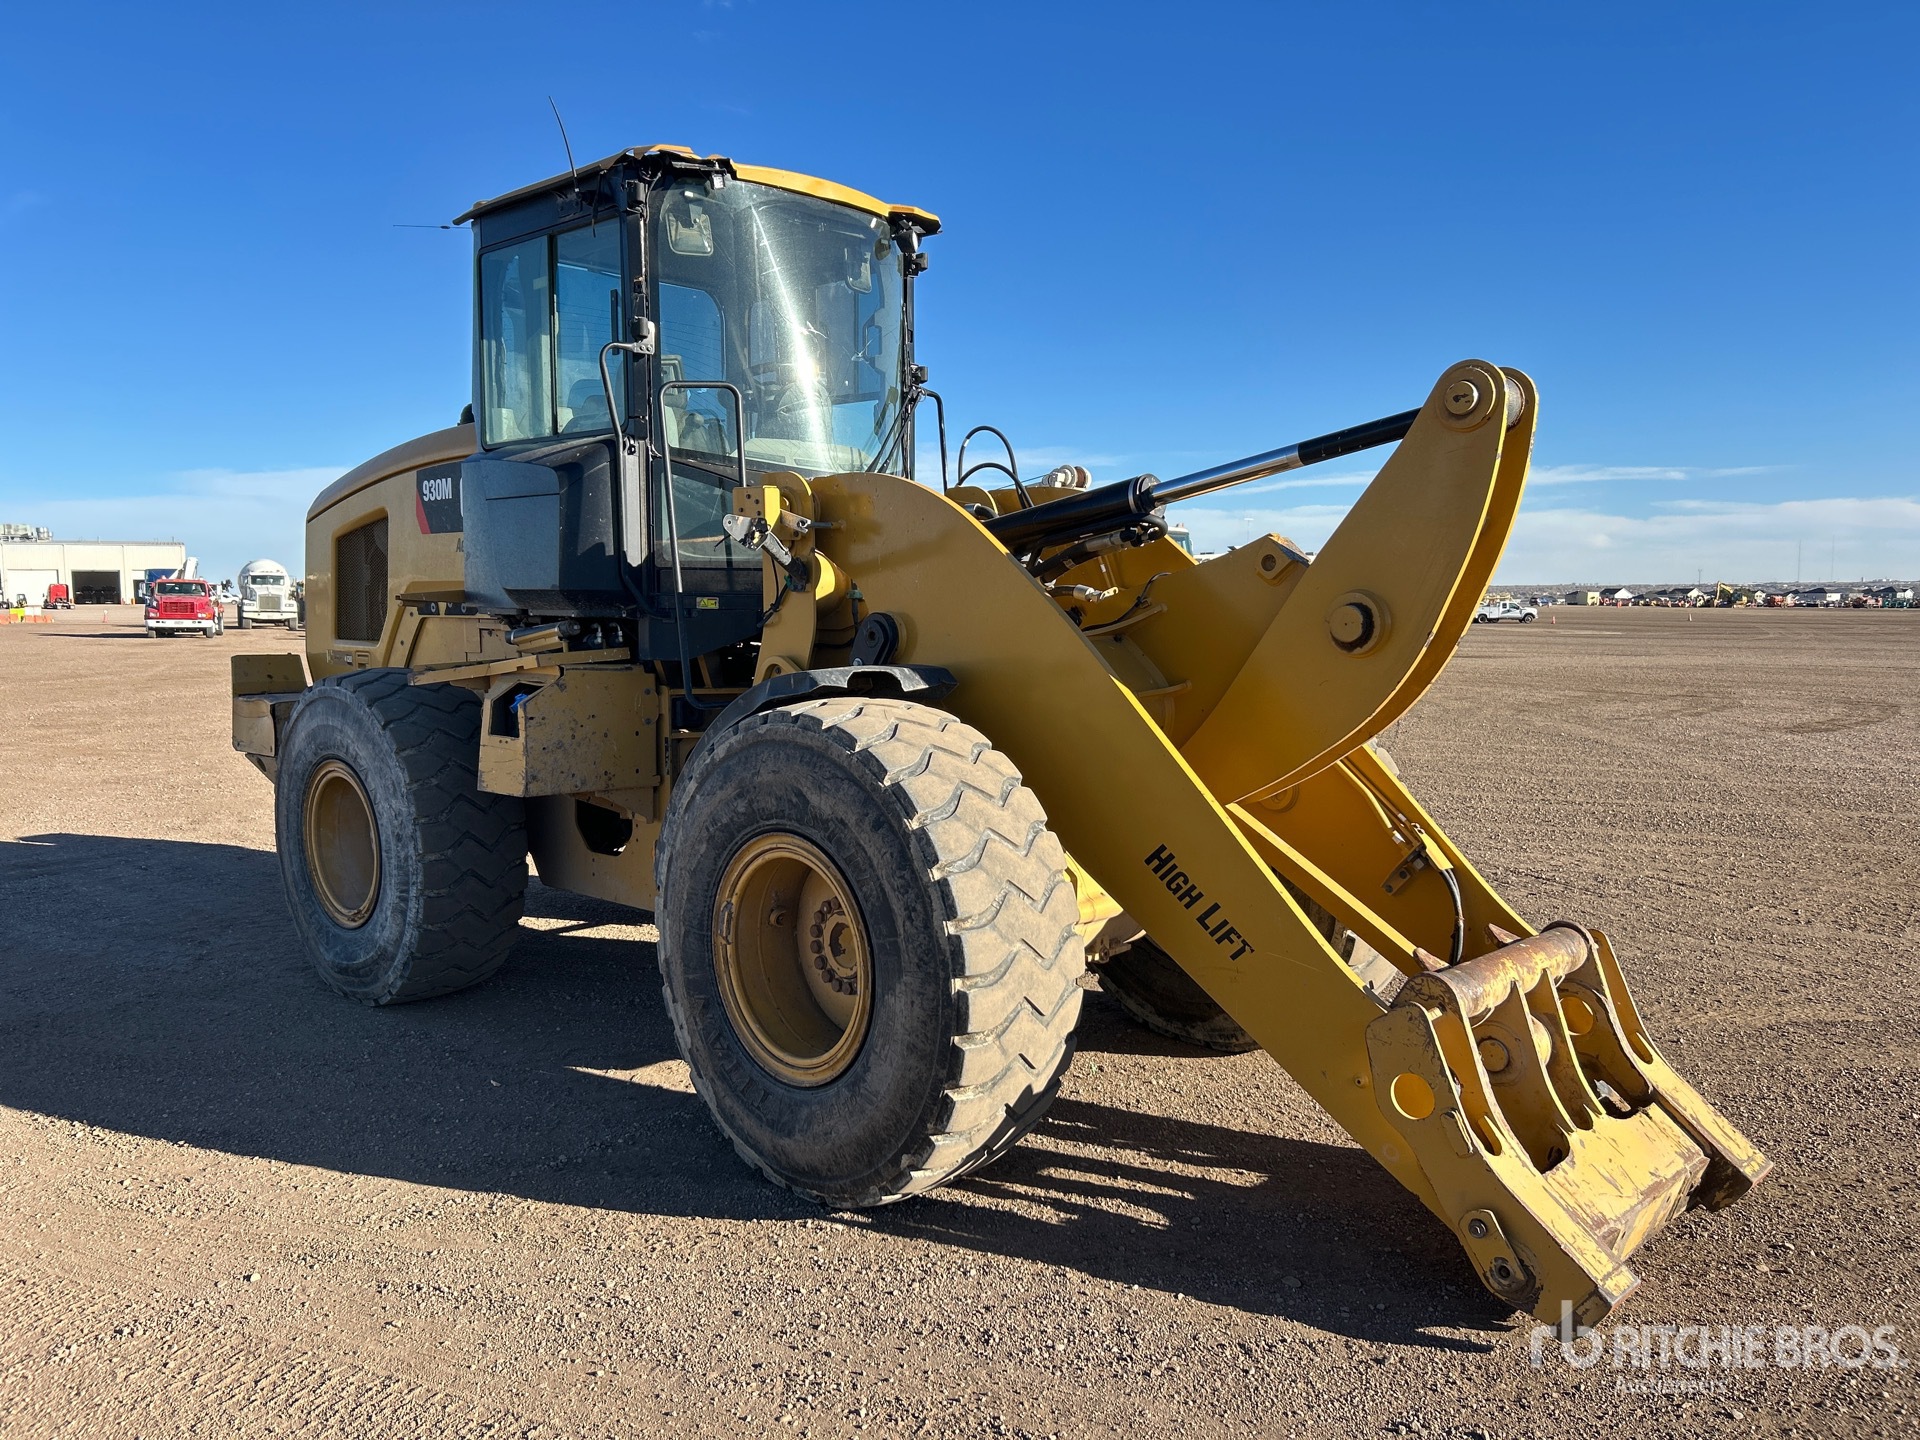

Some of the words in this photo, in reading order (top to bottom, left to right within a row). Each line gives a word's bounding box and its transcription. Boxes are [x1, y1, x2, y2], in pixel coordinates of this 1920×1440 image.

[423, 478, 452, 501] 930M
[1144, 844, 1204, 910] HIGH
[1196, 902, 1255, 961] LIFT
